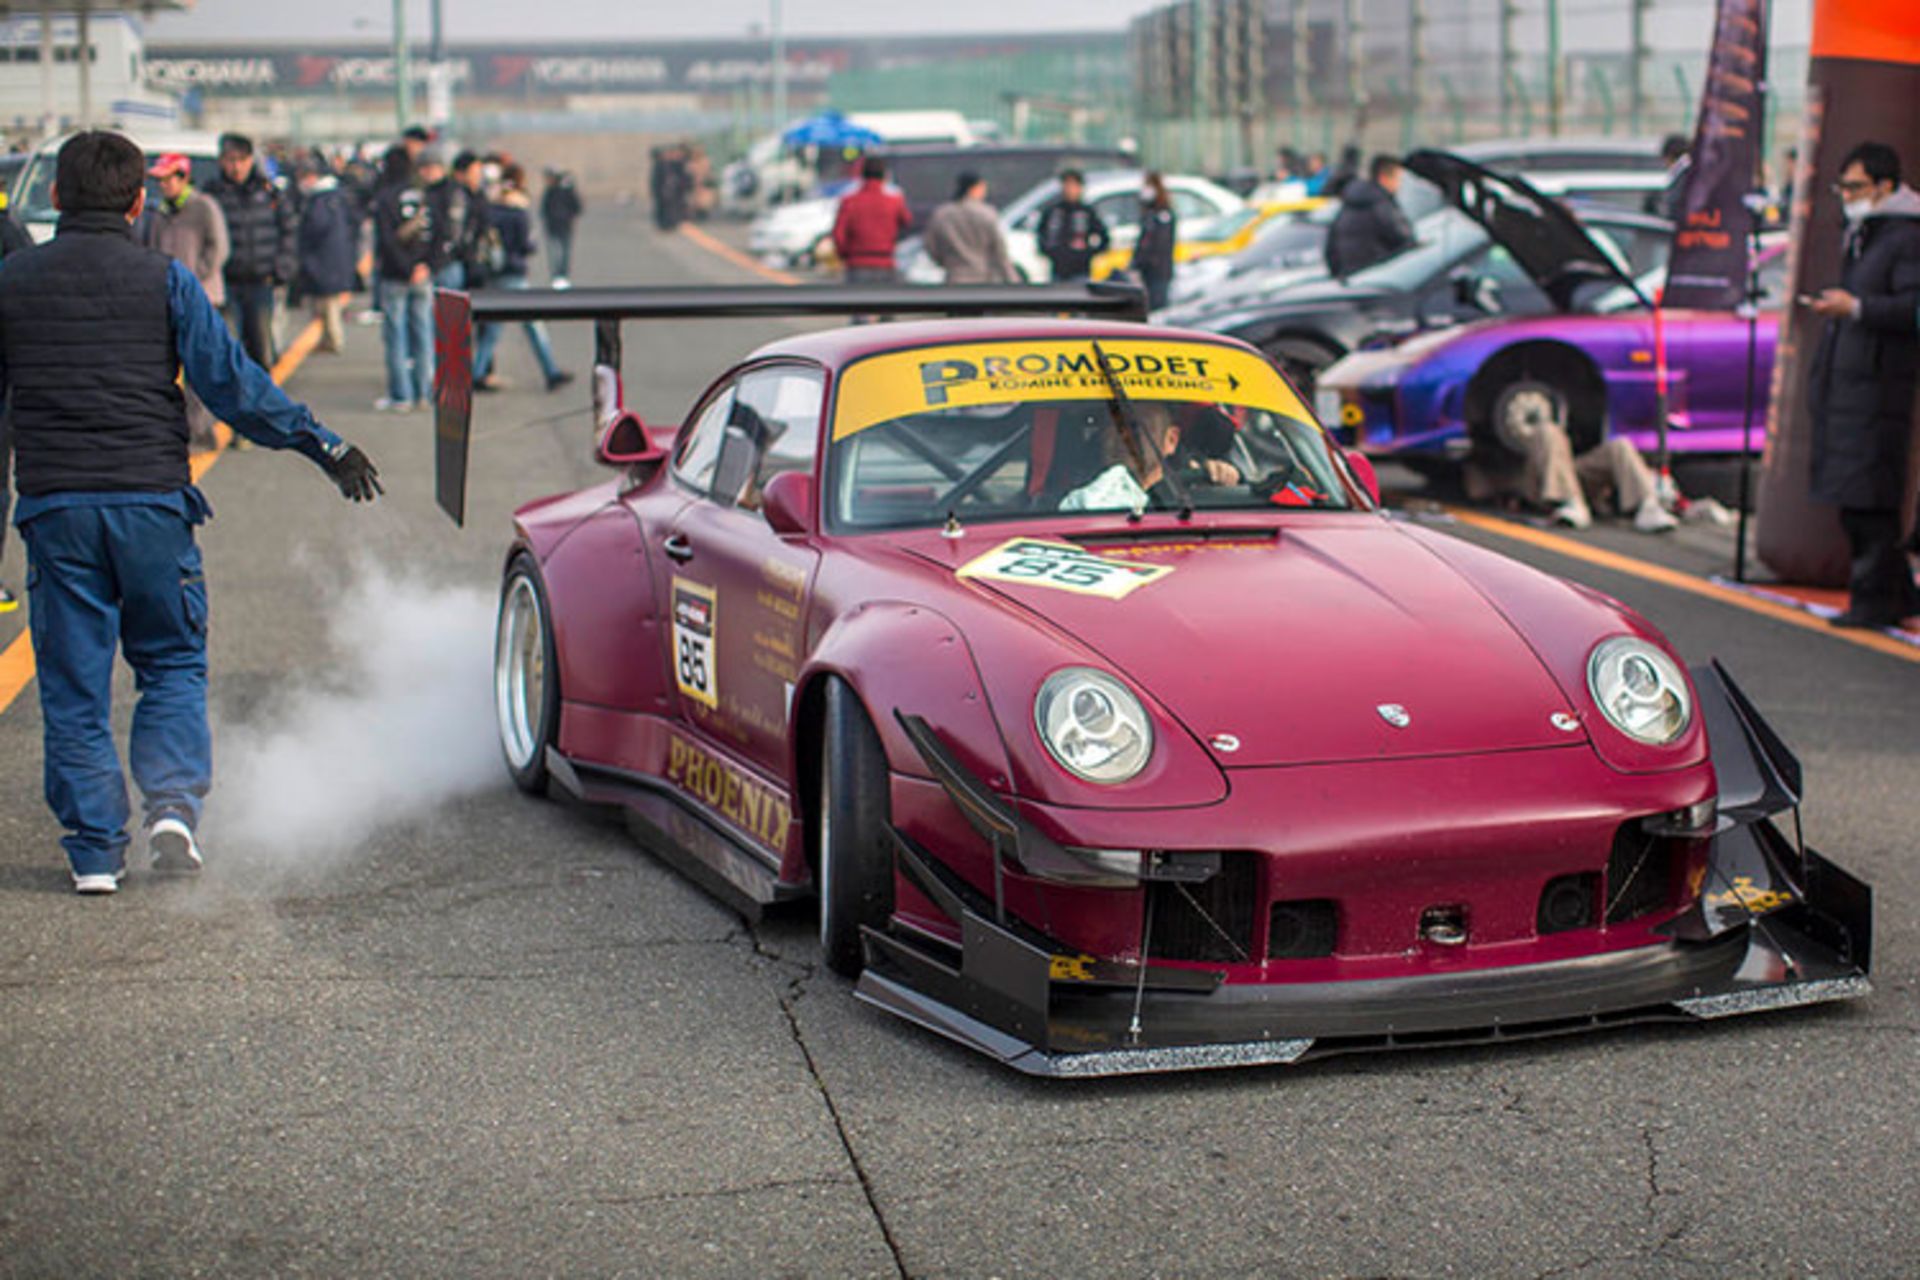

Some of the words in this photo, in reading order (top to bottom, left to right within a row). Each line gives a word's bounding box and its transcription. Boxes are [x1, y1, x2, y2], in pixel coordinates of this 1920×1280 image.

[328, 57, 470, 84] YOKOAA
[920, 352, 1209, 405] PROMODET
[1079, 376, 1214, 392] ENINEERING
[998, 557, 1114, 586] 85
[680, 635, 708, 692] 85
[668, 733, 792, 851] PHOENIX
